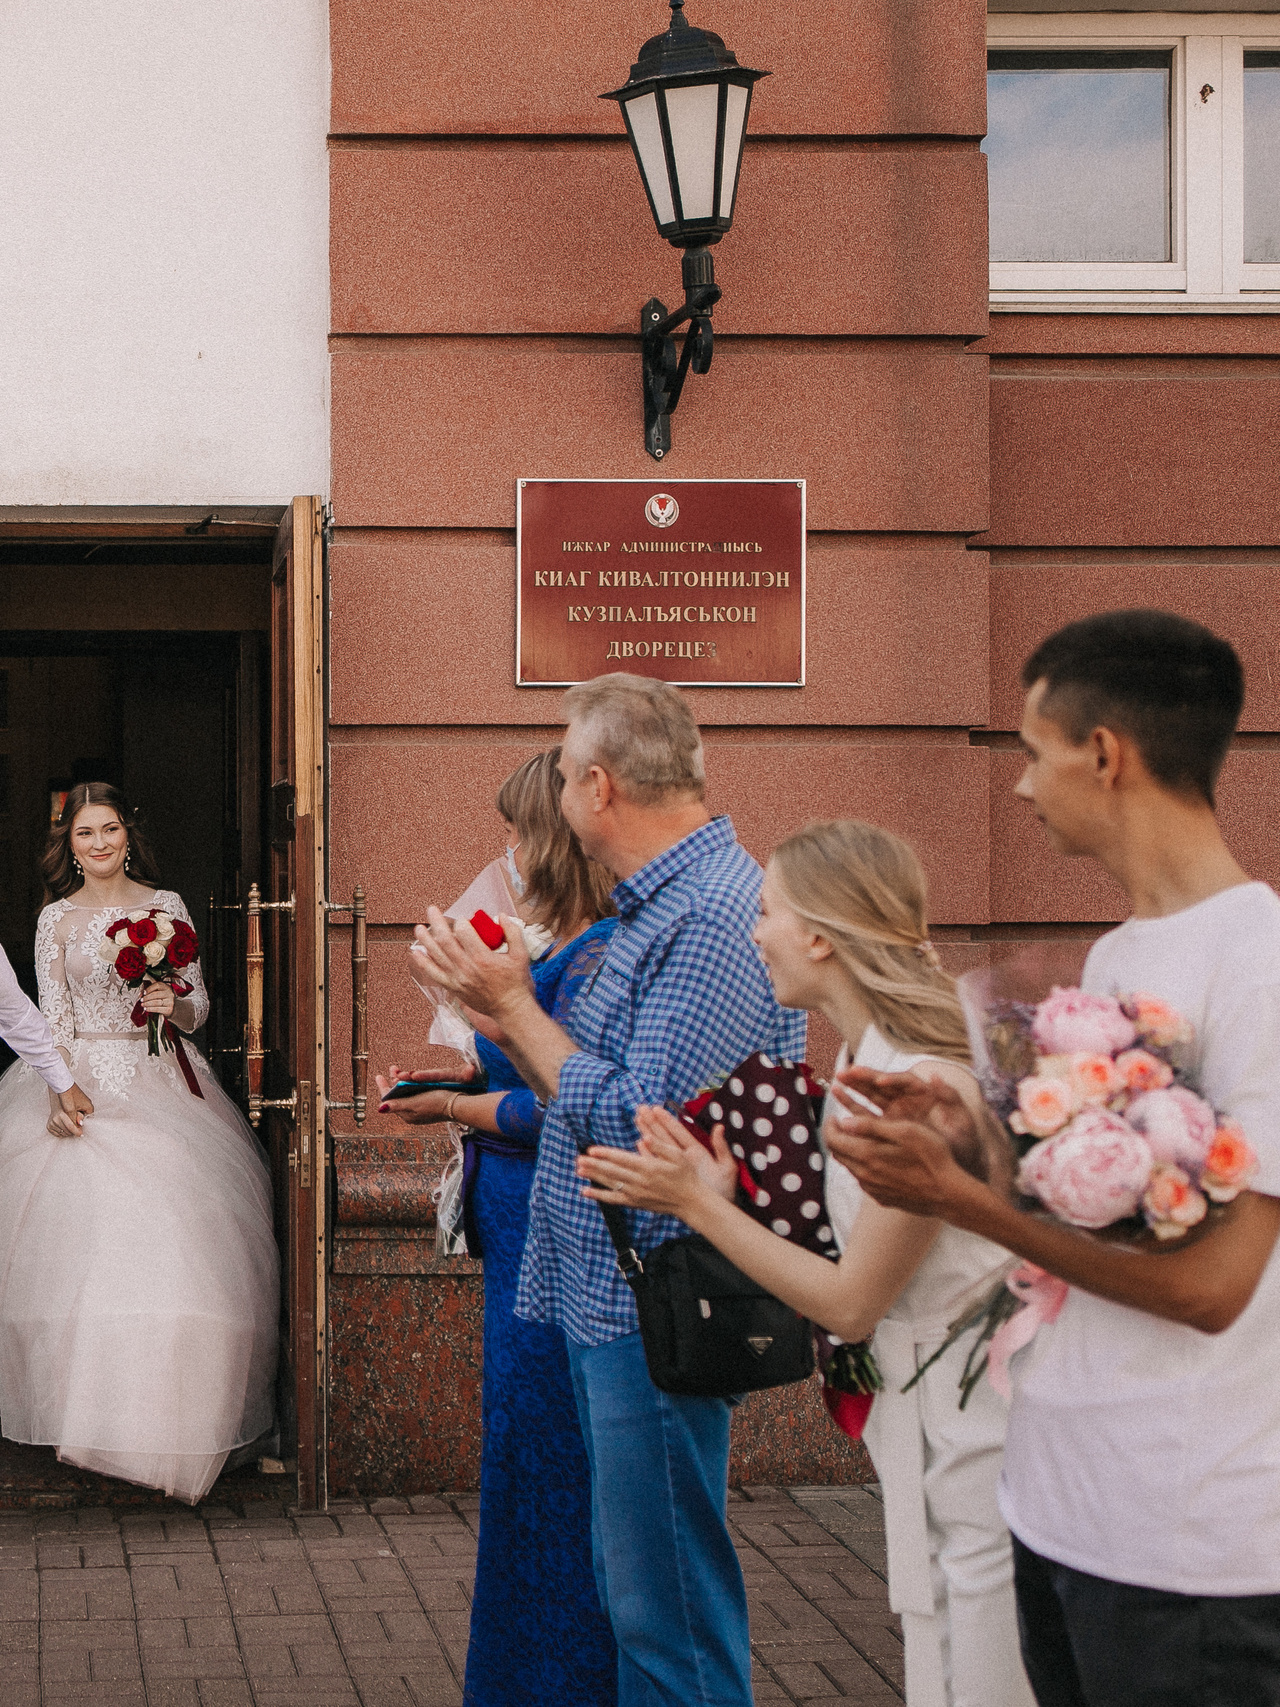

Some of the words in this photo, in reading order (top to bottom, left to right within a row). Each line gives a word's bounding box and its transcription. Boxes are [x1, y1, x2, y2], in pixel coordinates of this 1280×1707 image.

[562, 541, 611, 552] ИЖКАР
[534, 570, 592, 587] КИАГ
[598, 570, 790, 588] КИВАЛТОННИЛЭН
[568, 606, 757, 623] КУЗПАЛЪЯСЬКОН
